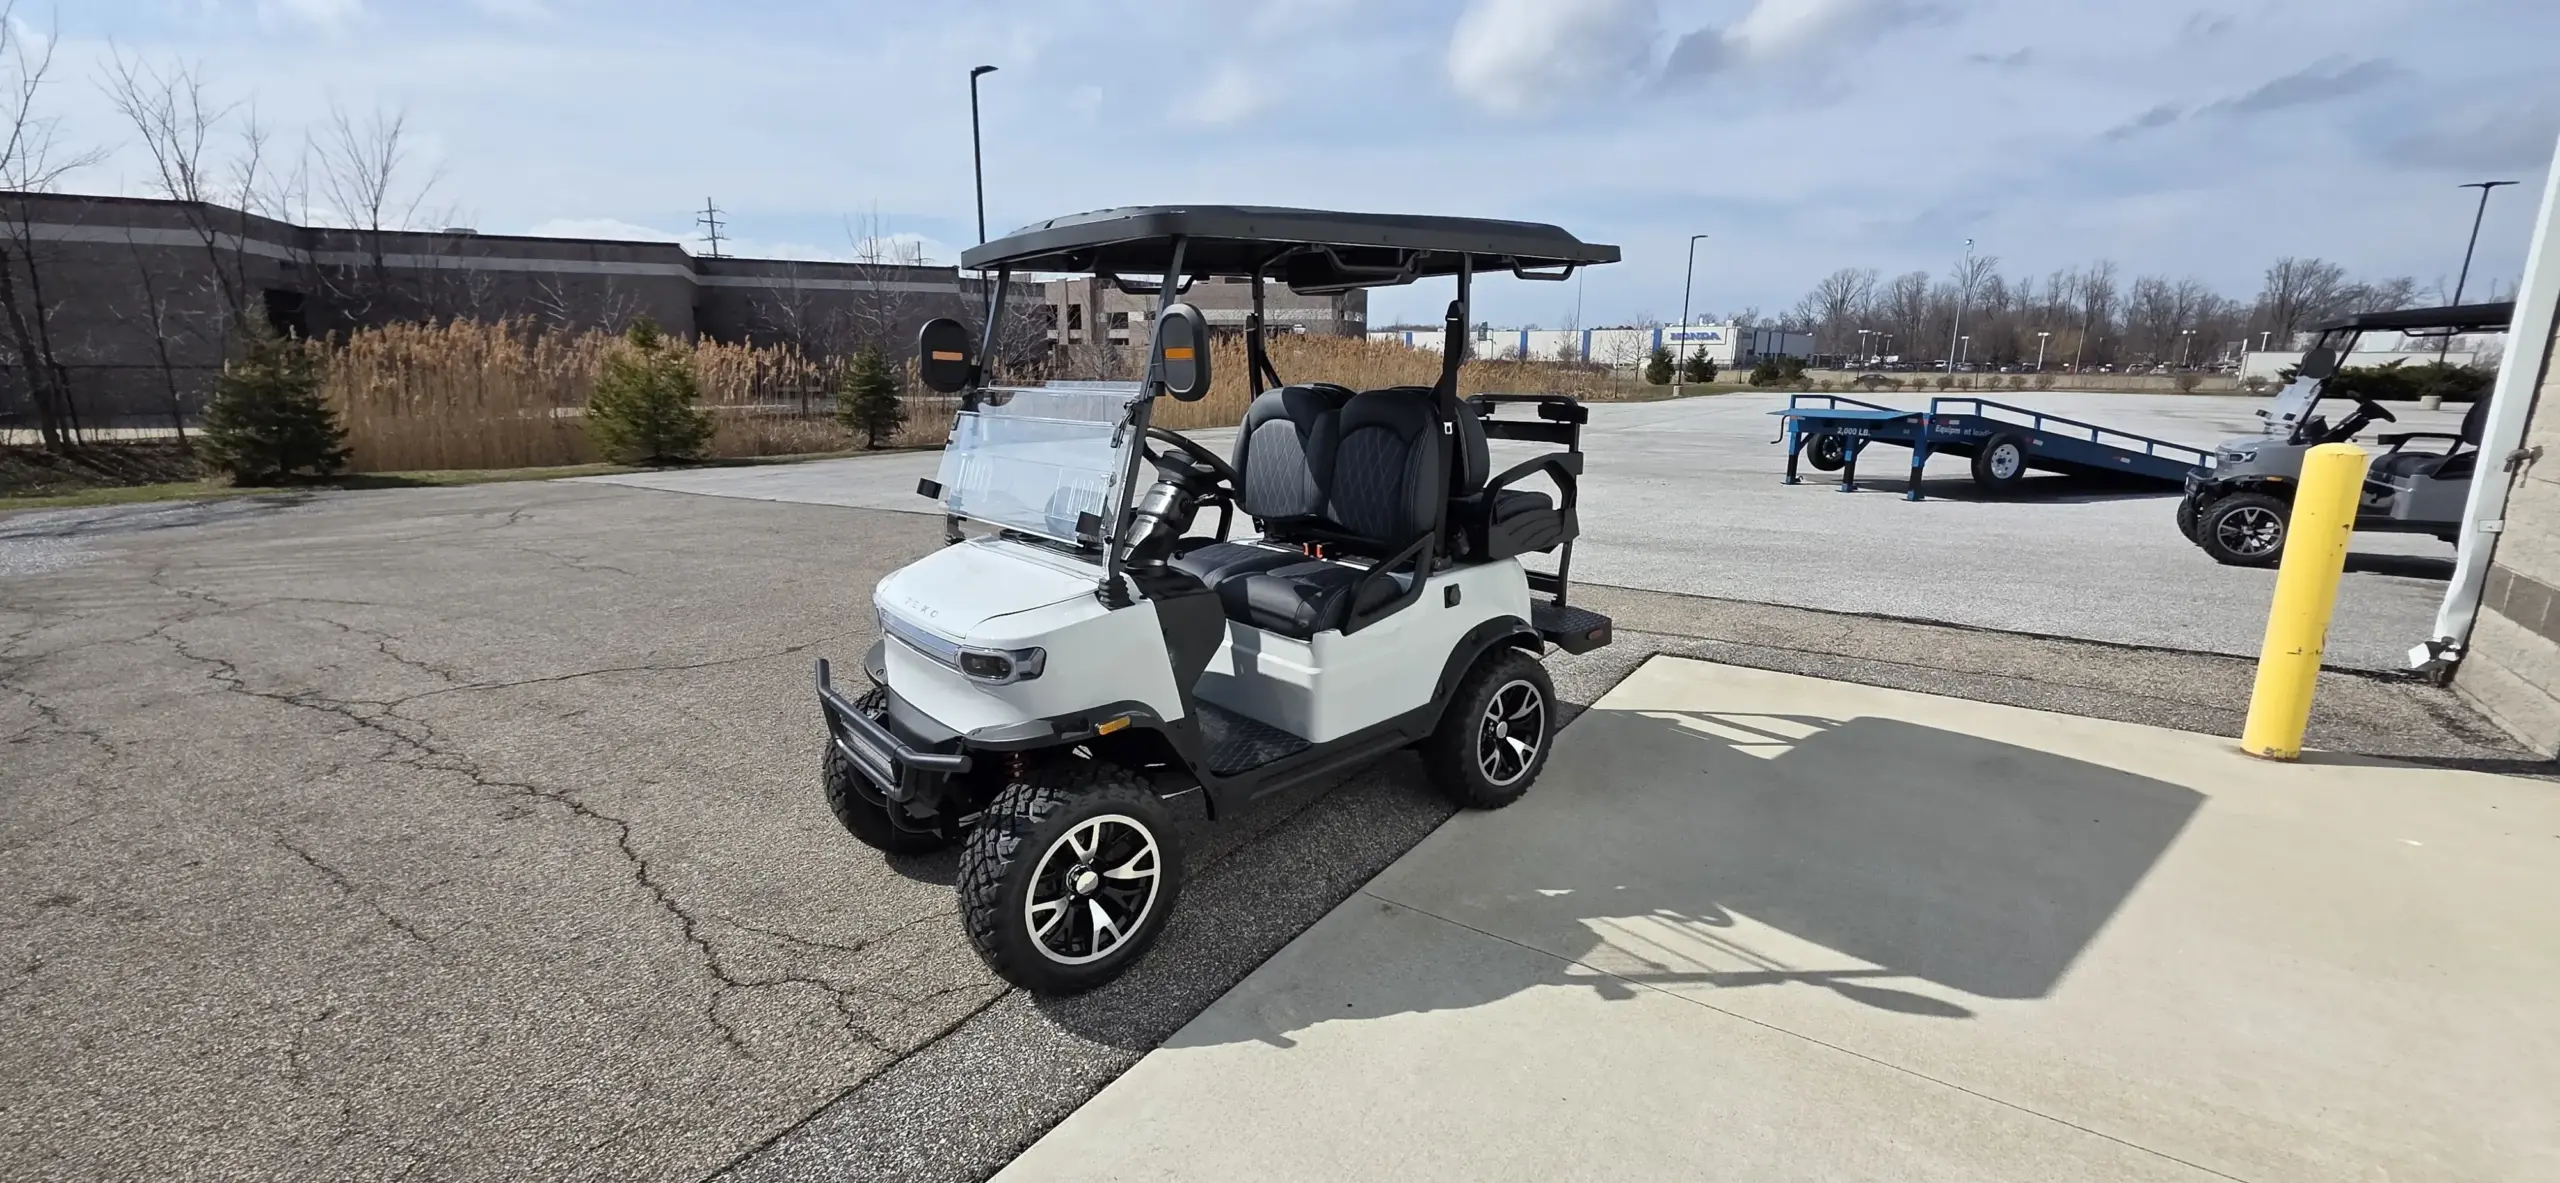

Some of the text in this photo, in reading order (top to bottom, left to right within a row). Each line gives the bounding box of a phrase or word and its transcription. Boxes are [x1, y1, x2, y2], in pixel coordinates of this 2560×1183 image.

[1670, 332, 1722, 341] HONDA
[1837, 427, 1871, 437] 2,000 LB.
